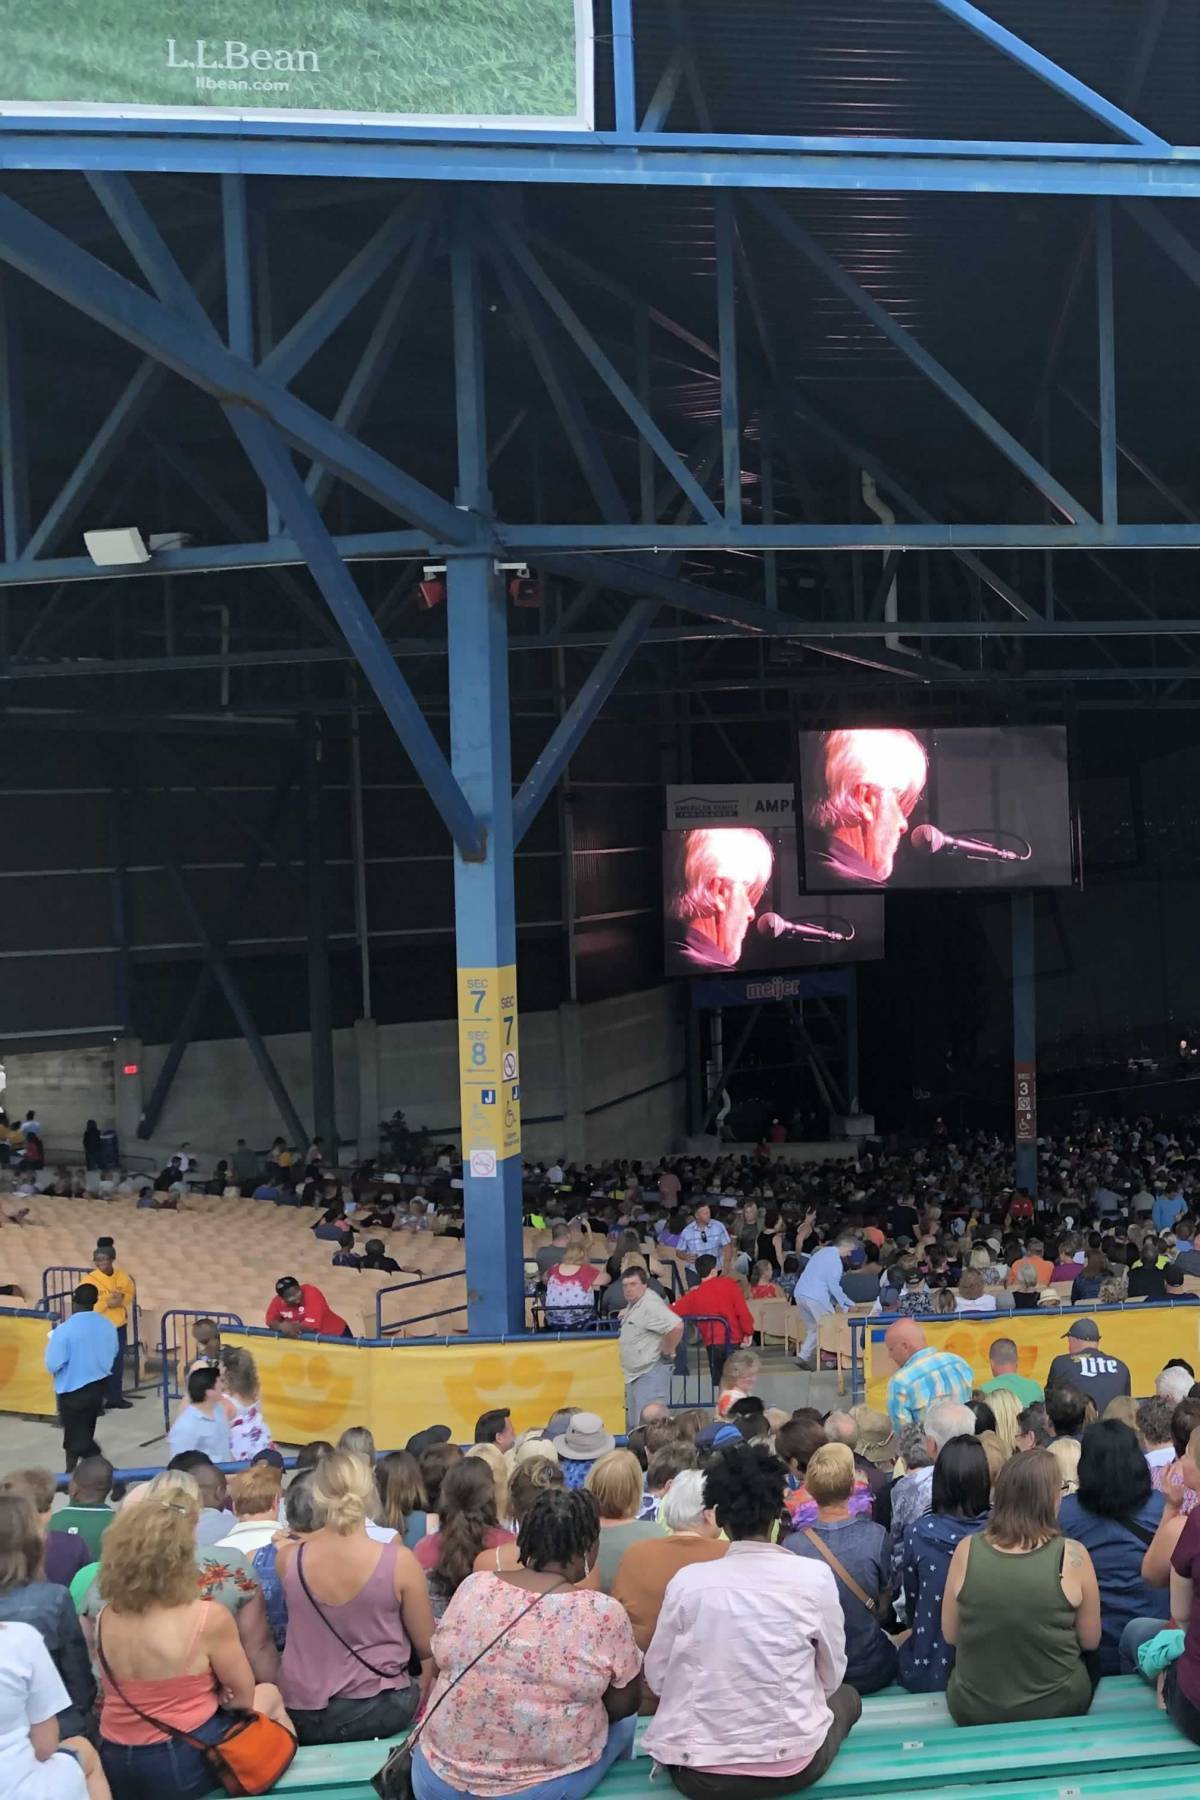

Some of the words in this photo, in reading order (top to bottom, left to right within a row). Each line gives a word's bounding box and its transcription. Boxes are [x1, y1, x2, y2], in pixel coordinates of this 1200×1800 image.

[167, 39, 320, 72] L.L.Bean
[196, 76, 289, 91] llbean.com
[467, 978, 488, 989] SEC
[746, 976, 801, 1000] meijer
[469, 990, 486, 1013] 7
[500, 995, 515, 1009] SEC
[467, 1030, 490, 1041] SEC
[503, 1015, 514, 1046] 7
[471, 1042, 487, 1066] 8
[1019, 1081, 1029, 1096] 3
[1079, 1356, 1118, 1377] Lite
